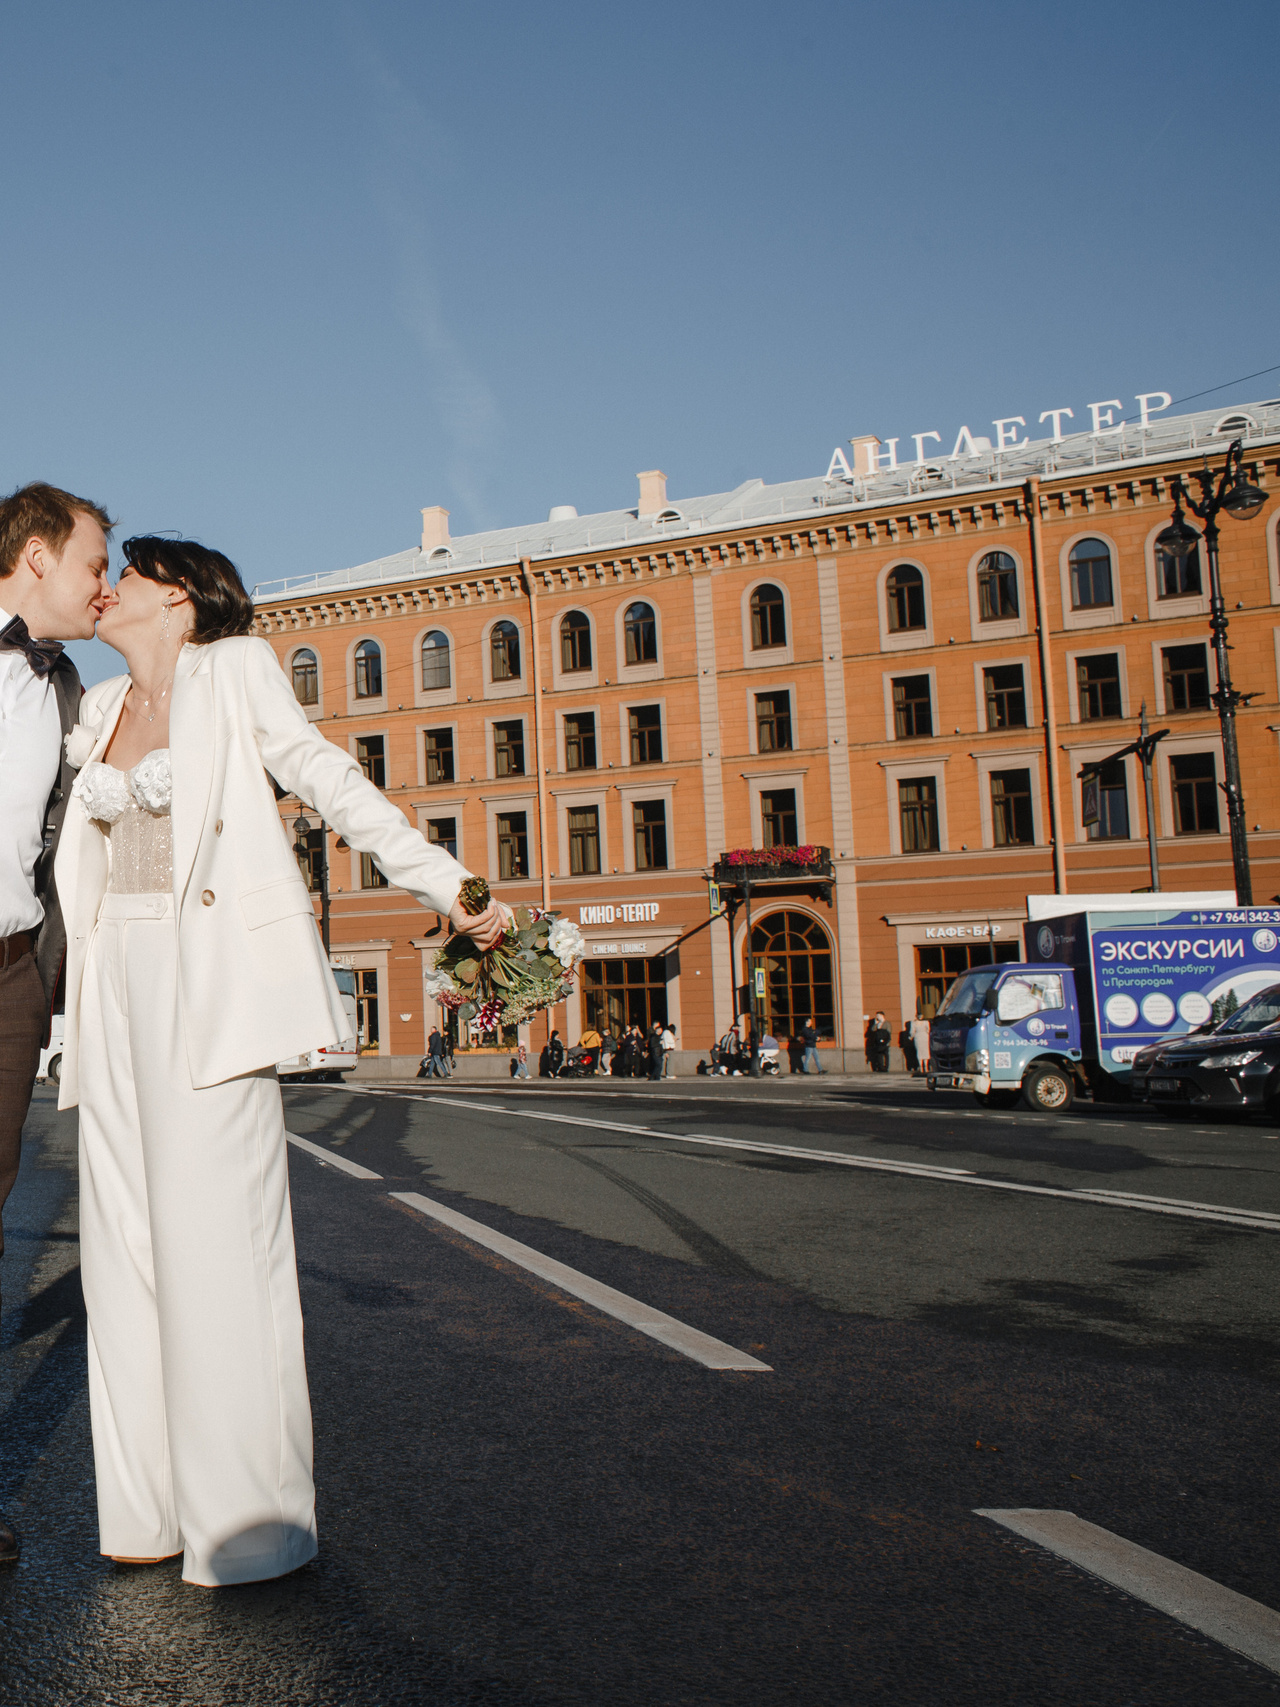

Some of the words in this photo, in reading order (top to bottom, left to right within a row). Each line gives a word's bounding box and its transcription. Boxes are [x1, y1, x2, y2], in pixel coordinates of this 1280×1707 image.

[823, 391, 1172, 483] АНГЛЕТЕР
[1210, 912, 1223, 923] +7
[1225, 912, 1246, 923] 964
[592, 943, 618, 955] CINEMA
[621, 942, 647, 954] LOUNGE
[1100, 938, 1245, 961] ЭКСКУРСИИ
[1102, 967, 1115, 975] по
[1116, 963, 1215, 976] Санкт-Петербургу
[1103, 979, 1110, 987] и
[1111, 977, 1174, 988] Пригородам
